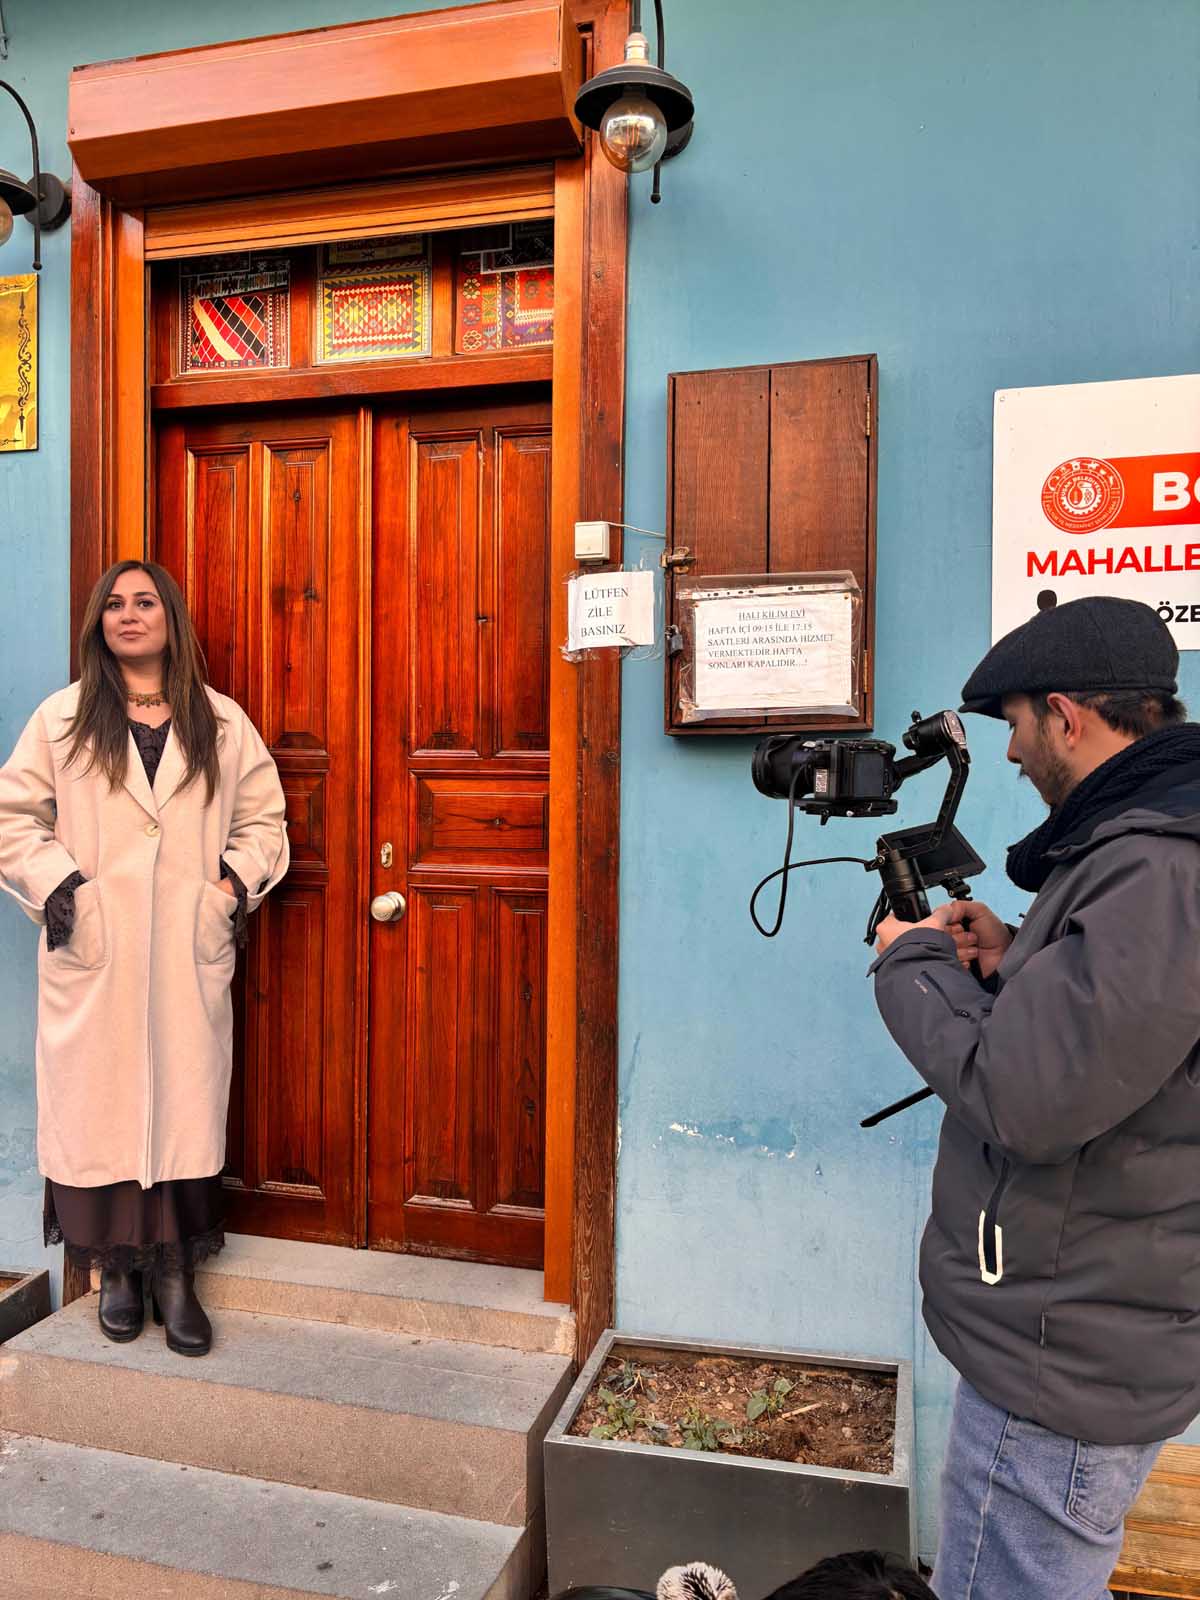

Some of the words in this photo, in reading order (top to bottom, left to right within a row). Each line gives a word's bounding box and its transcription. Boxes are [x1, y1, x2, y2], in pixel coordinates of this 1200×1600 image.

[1152, 471, 1200, 512] B
[1027, 543, 1200, 577] MAHALLE
[584, 587, 629, 601] LÜTFEN
[587, 605, 613, 619] ZİLE
[738, 611, 760, 621] HALI
[790, 607, 806, 618] EVİ
[581, 624, 626, 638] BASINIZ
[708, 626, 737, 636] HAFTA
[738, 624, 751, 635] İÇİ
[775, 623, 789, 632] İLE
[707, 637, 750, 647] SAATLERİ
[752, 635, 799, 645] ARASINDA
[800, 633, 833, 644] HİZMET
[708, 660, 746, 670] SONLARI
